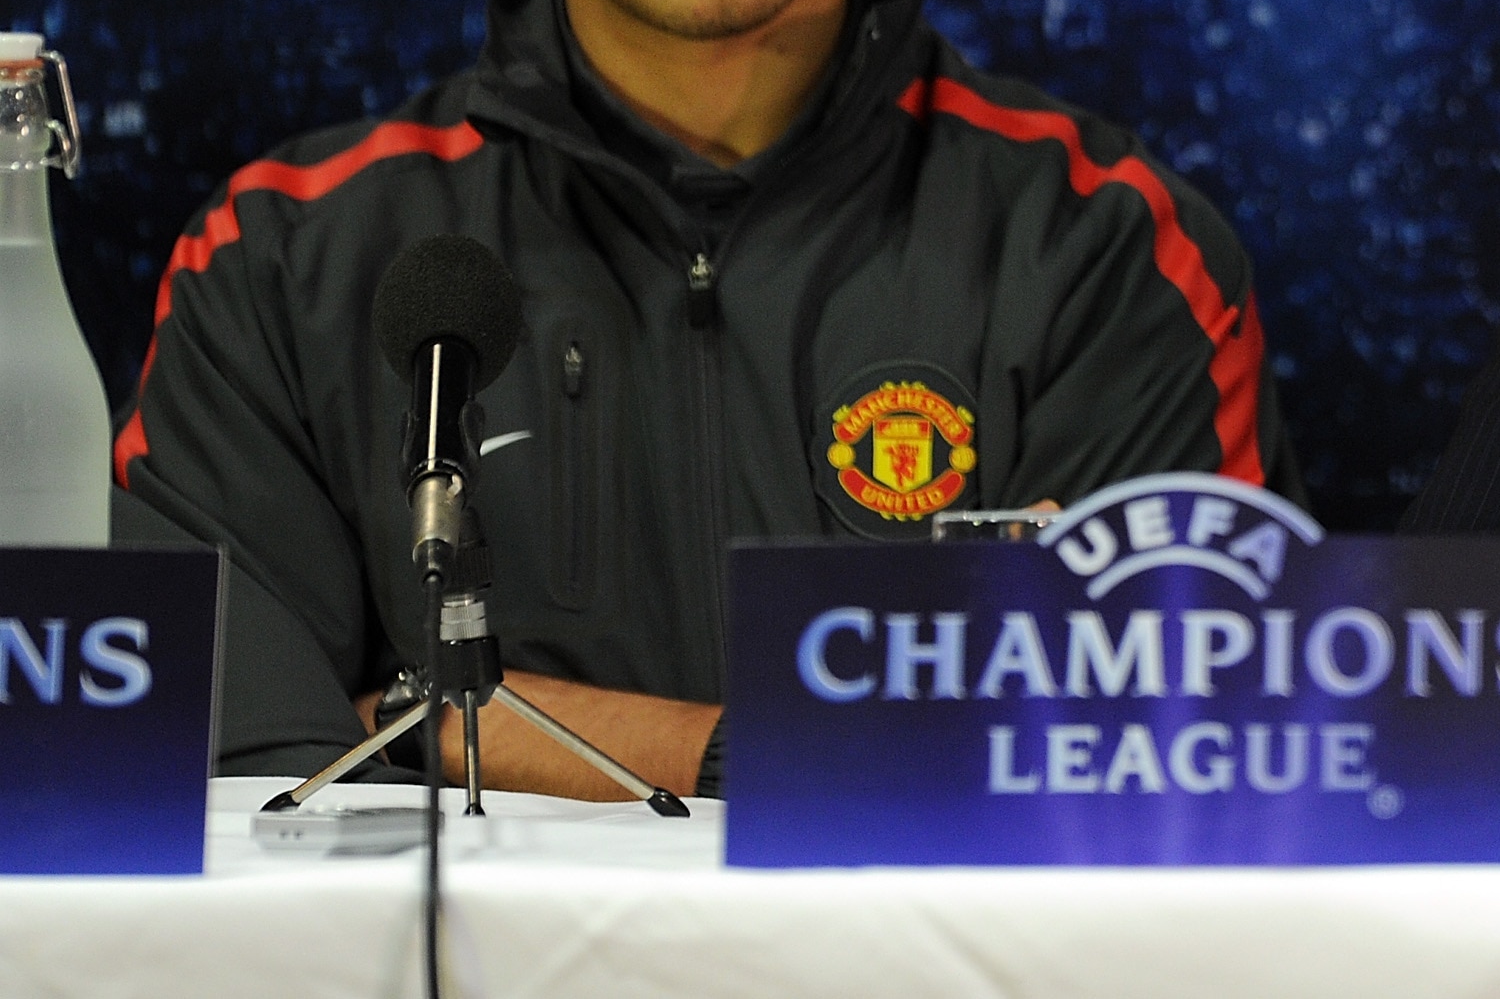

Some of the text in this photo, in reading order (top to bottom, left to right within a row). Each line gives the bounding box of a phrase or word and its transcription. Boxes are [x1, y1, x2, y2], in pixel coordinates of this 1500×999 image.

[848, 392, 961, 435] MANCHESTER
[860, 486, 945, 510] UNITED
[1055, 494, 1288, 585] UEFA
[987, 721, 1376, 794] LEAGUE
